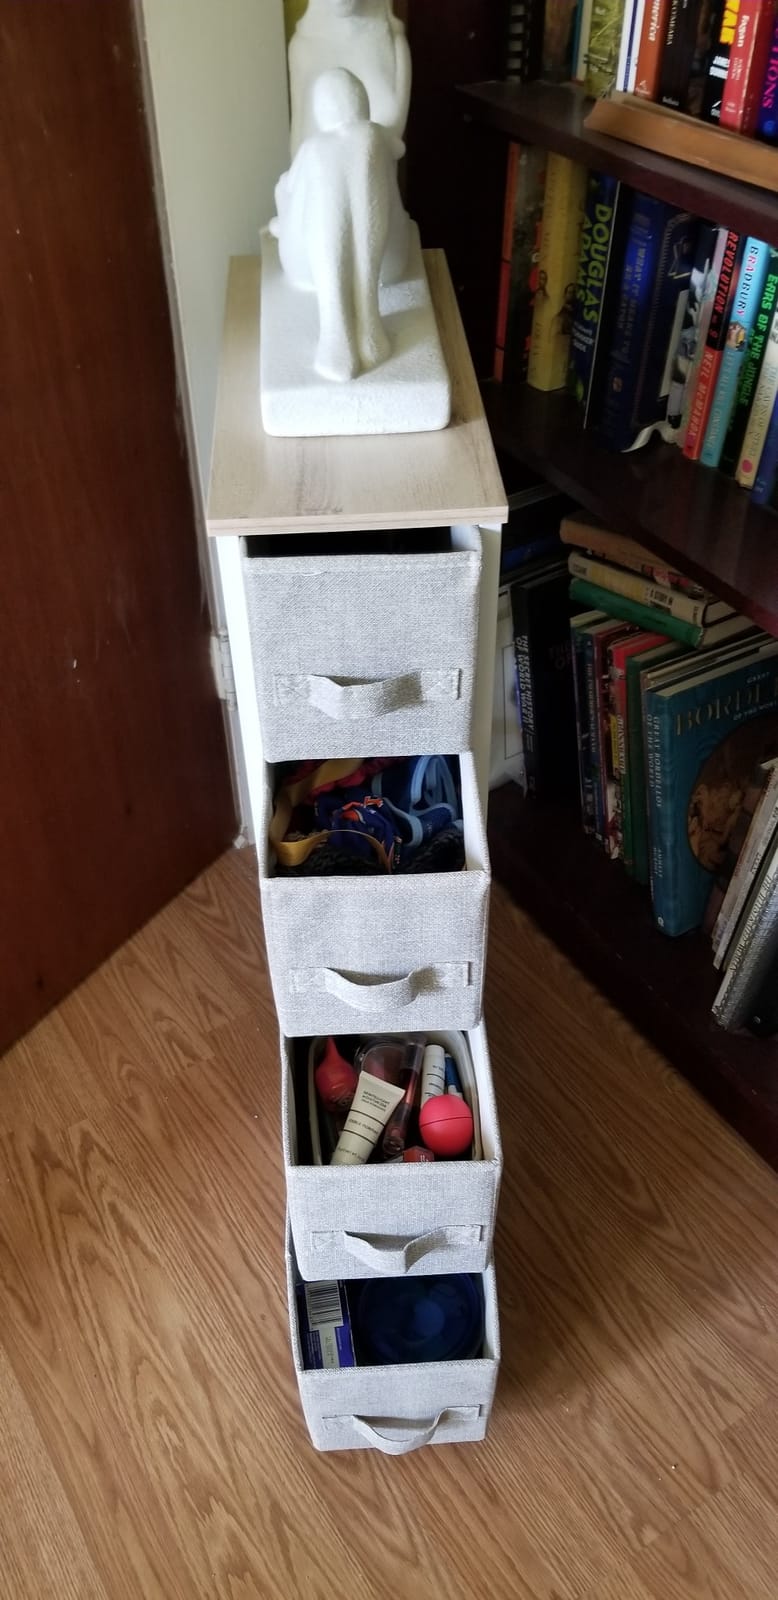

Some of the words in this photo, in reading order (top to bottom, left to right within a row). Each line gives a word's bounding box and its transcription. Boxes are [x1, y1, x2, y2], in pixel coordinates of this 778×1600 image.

[648, 0, 660, 41] merica
[577, 216, 593, 301] ADAMS
[584, 203, 612, 321] DOUGLAS
[714, 232, 738, 312] REVOLUTION
[737, 246, 759, 317] BRADBURY
[762, 274, 778, 310] EARS
[758, 313, 770, 332] OF
[701, 350, 713, 377] NEIL
[752, 333, 765, 360] THE
[740, 361, 757, 406] JUNGLE
[516, 636, 523, 650] OF
[520, 634, 528, 653] THE
[518, 653, 527, 690] WORLD
[521, 655, 532, 691] SECRET
[524, 691, 535, 731] HISTORY
[646, 714, 652, 725] OF
[653, 752, 663, 808] BORDELLOS
